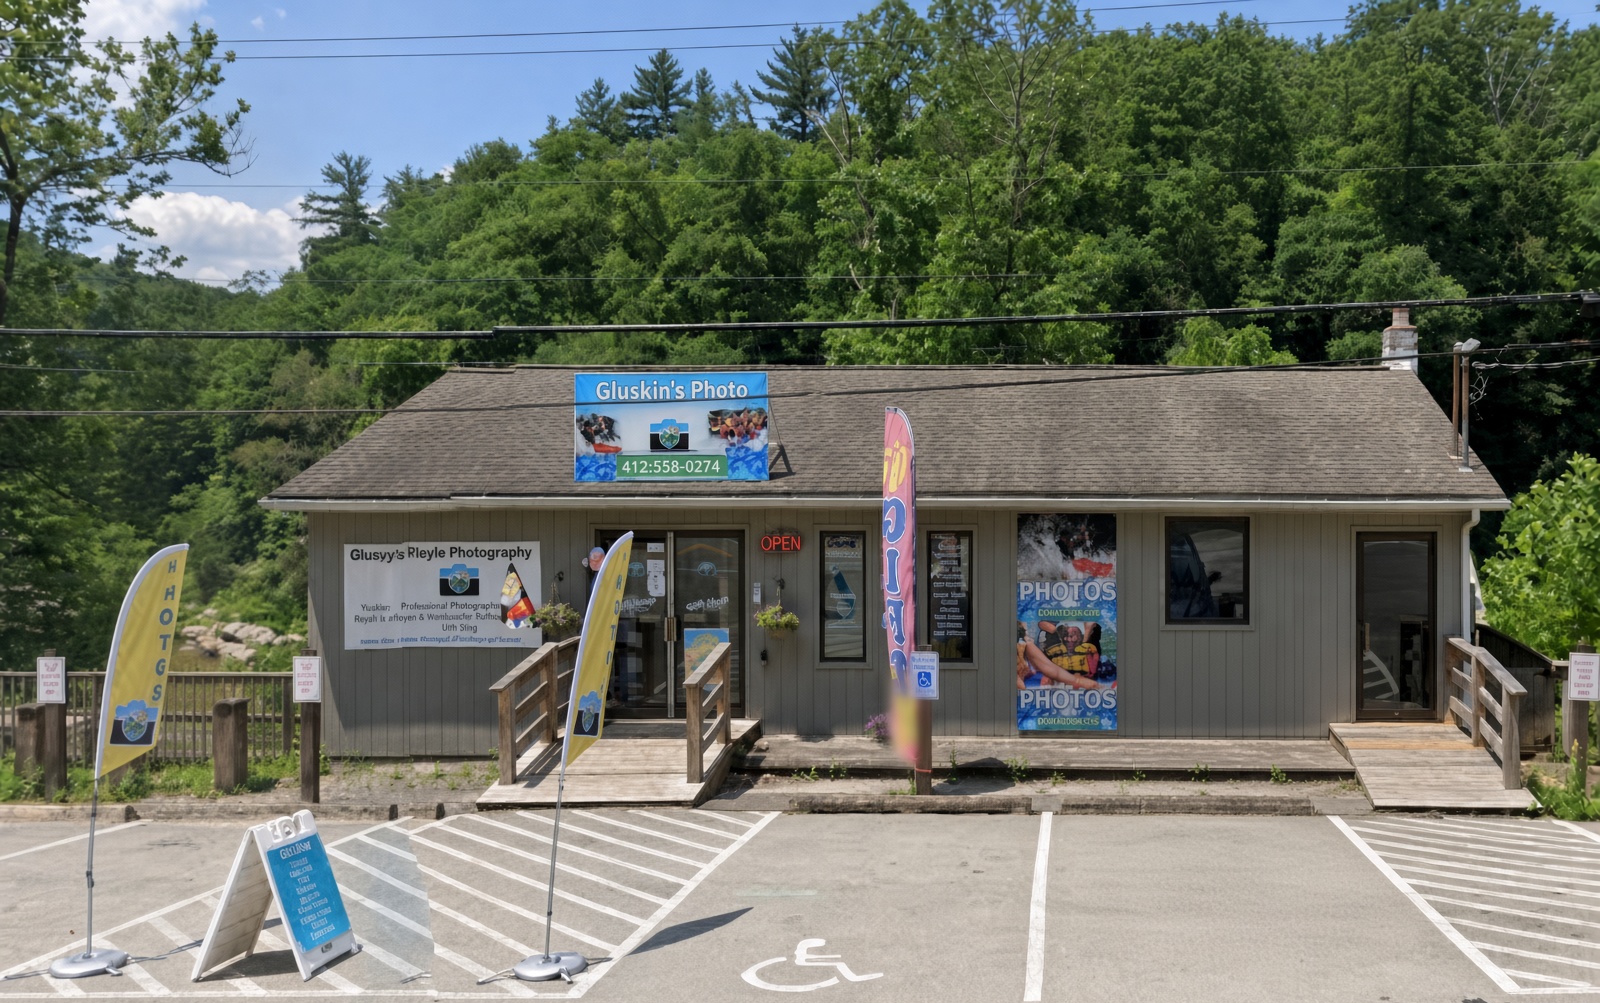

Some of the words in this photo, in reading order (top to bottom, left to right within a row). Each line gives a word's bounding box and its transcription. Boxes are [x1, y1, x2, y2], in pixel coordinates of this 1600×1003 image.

[596, 380, 686, 400] Gluskin's
[690, 379, 748, 399] Photo
[621, 459, 721, 474] 412:558-0274
[761, 536, 801, 551] OPEN
[449, 546, 532, 561] Photography
[1019, 581, 1117, 601] PHOTOS
[418, 613, 425, 621] &
[1019, 689, 1117, 709] PHOTOS
